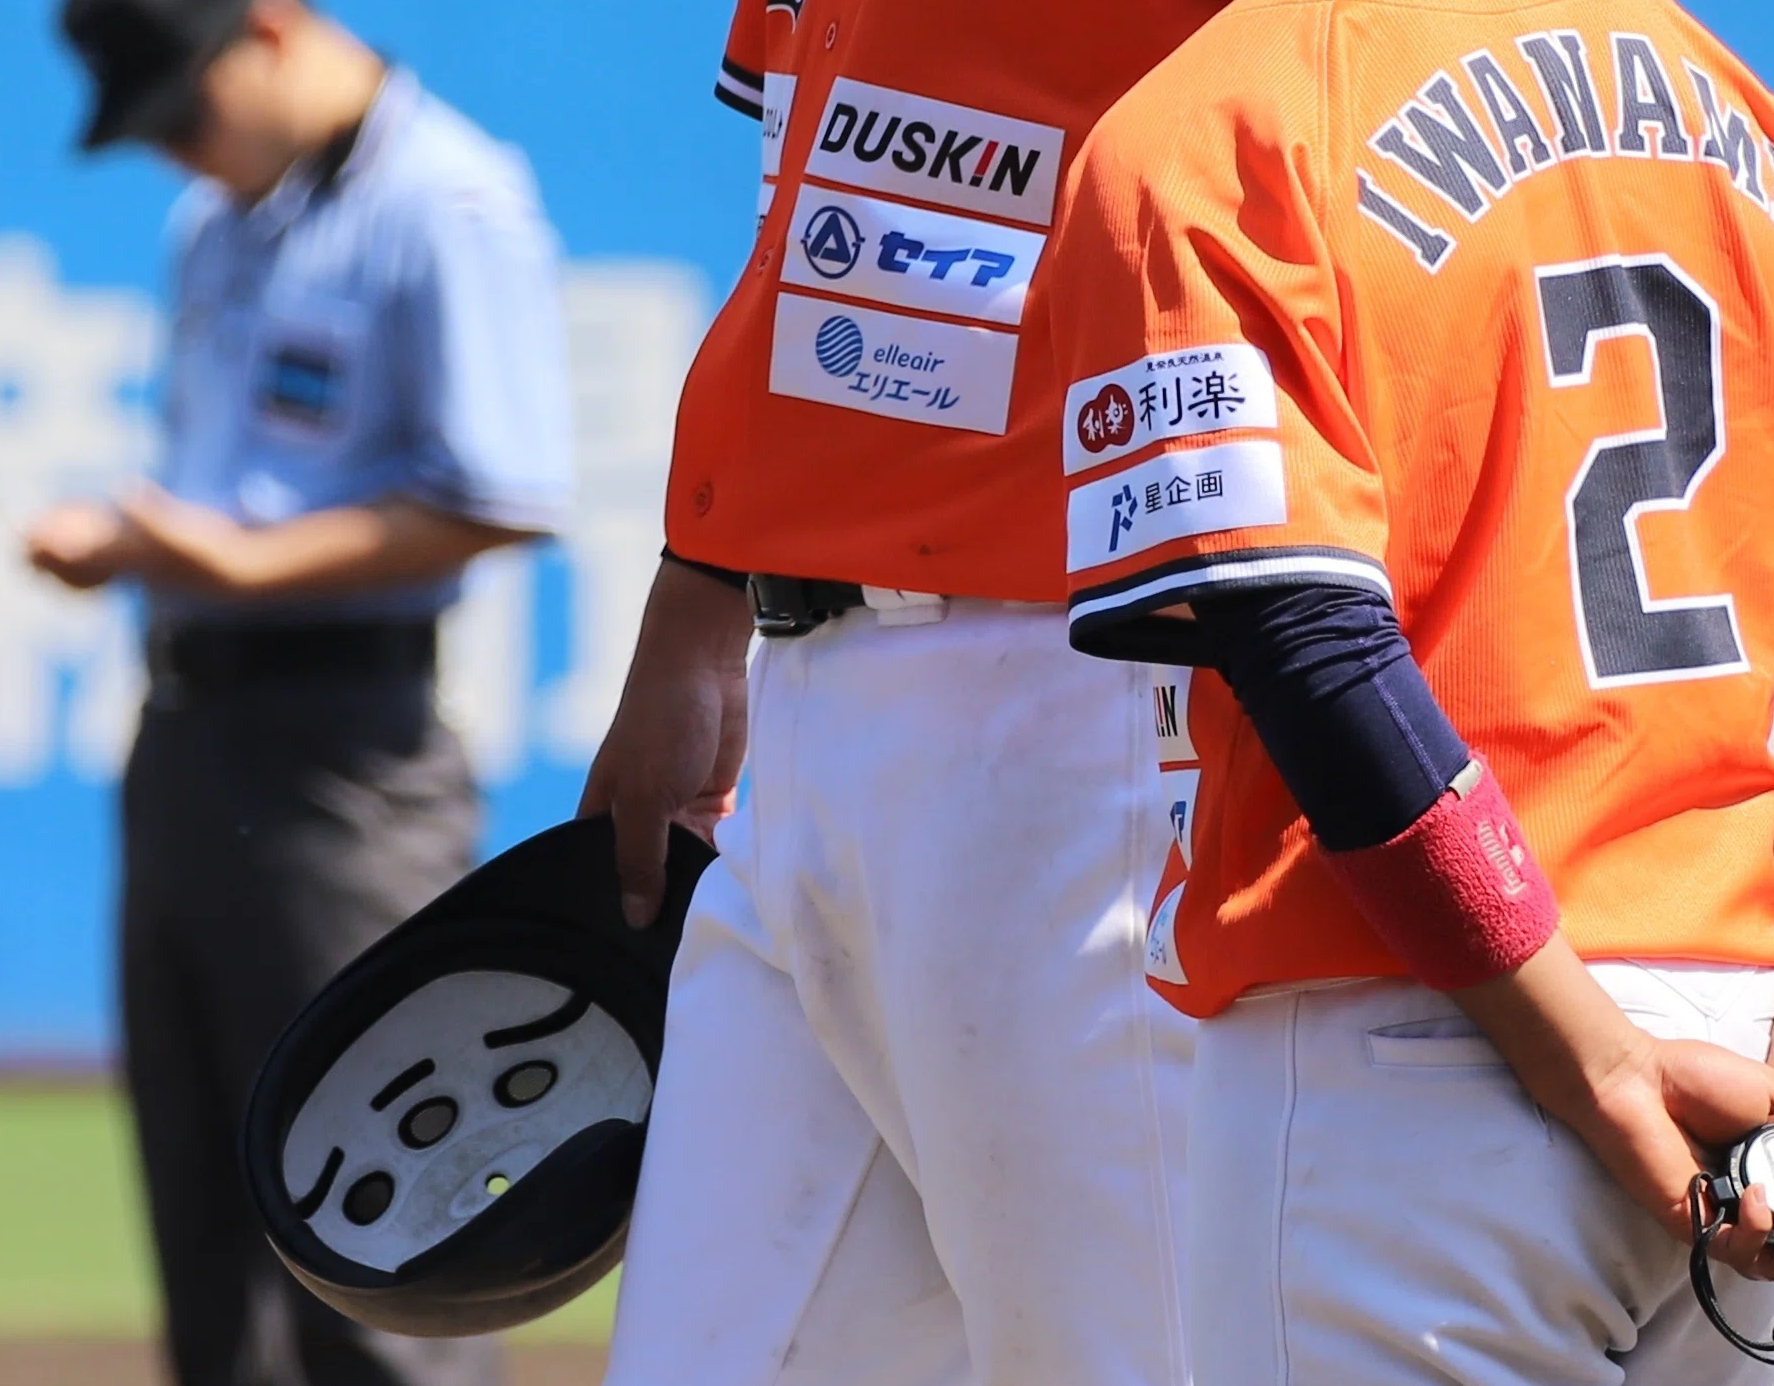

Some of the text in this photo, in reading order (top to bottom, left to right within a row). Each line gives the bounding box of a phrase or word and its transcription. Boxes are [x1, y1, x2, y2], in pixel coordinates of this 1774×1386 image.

[877, 231, 1015, 287] セイア
[873, 344, 944, 373] elleair
[847, 372, 960, 410] エリエール
[1139, 370, 1245, 431] 利楽
[1145, 470, 1223, 514] 星企画
[1533, 253, 1751, 690] 2
